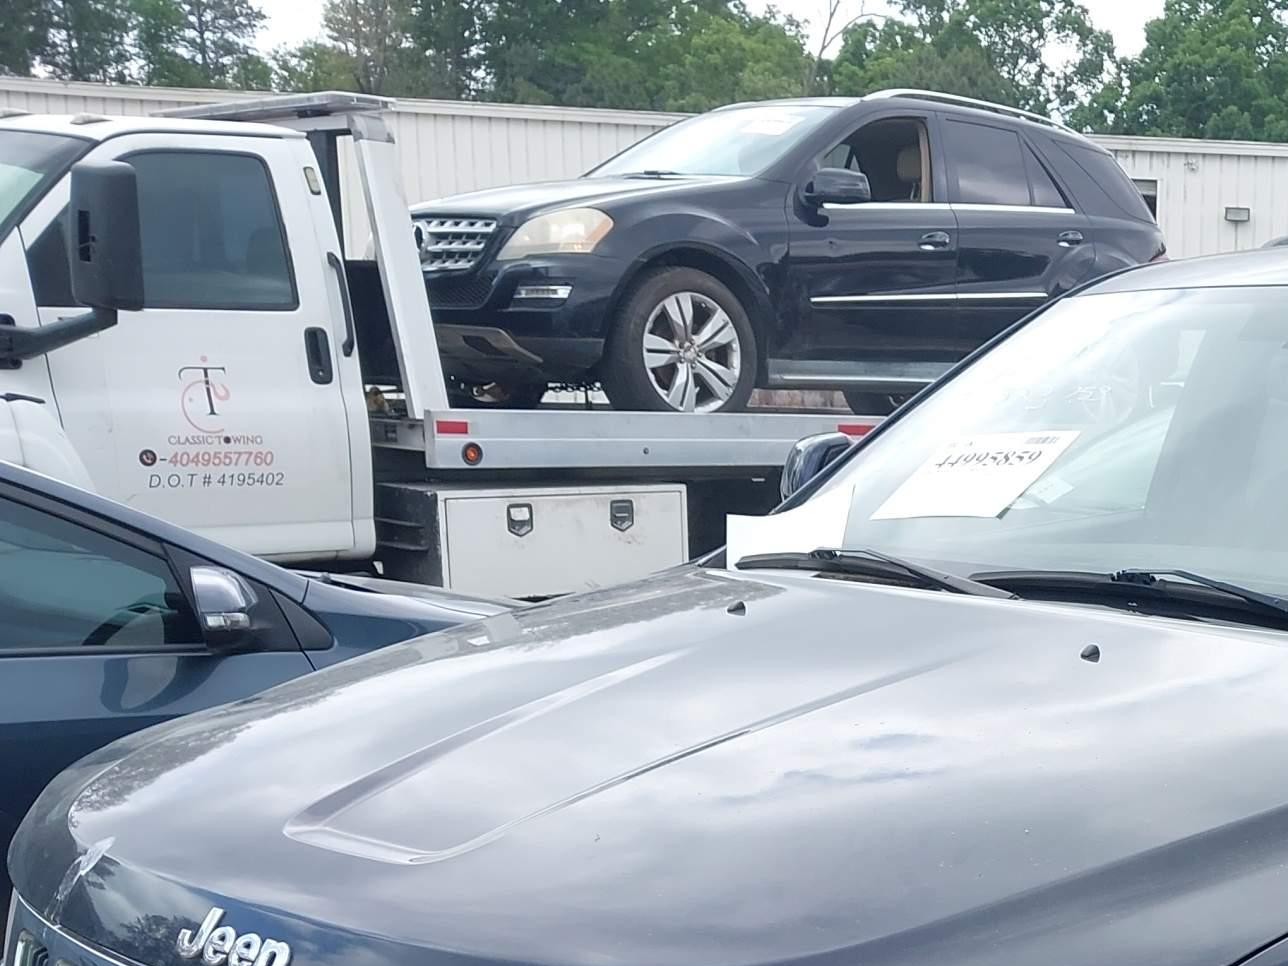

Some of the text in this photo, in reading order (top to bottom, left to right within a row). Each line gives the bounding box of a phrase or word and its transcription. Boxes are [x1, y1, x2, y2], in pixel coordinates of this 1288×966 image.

[149, 472, 285, 489] D.O.T # 4195402
